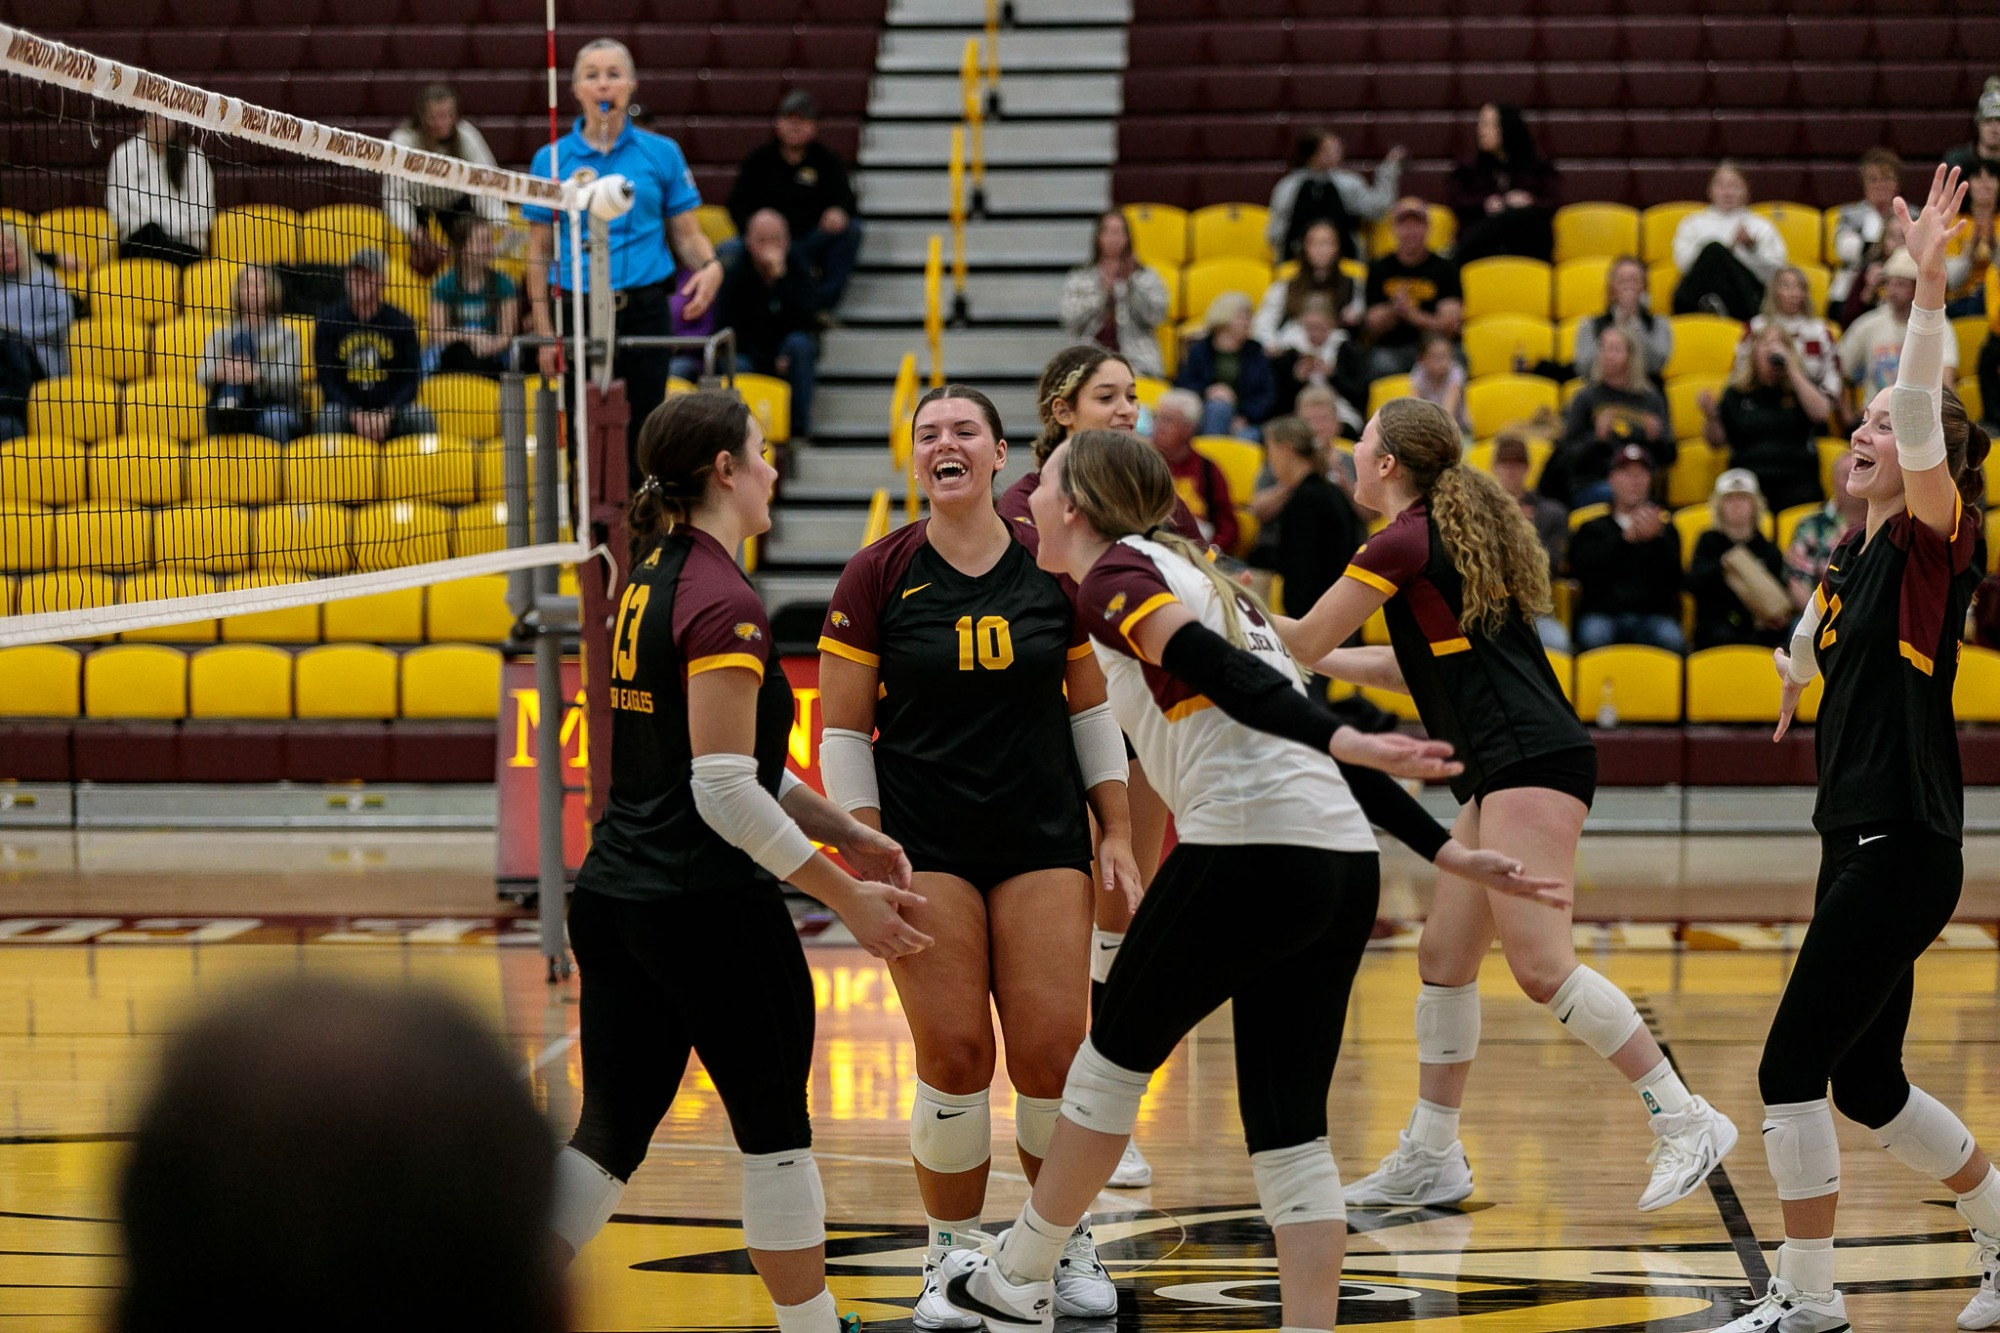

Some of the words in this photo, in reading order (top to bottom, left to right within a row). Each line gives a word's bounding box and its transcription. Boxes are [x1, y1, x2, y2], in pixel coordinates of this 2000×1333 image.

[611, 582, 650, 681] 13
[955, 615, 1015, 671] 10
[1819, 593, 1842, 650] 2
[620, 688, 654, 714] EAGLES
